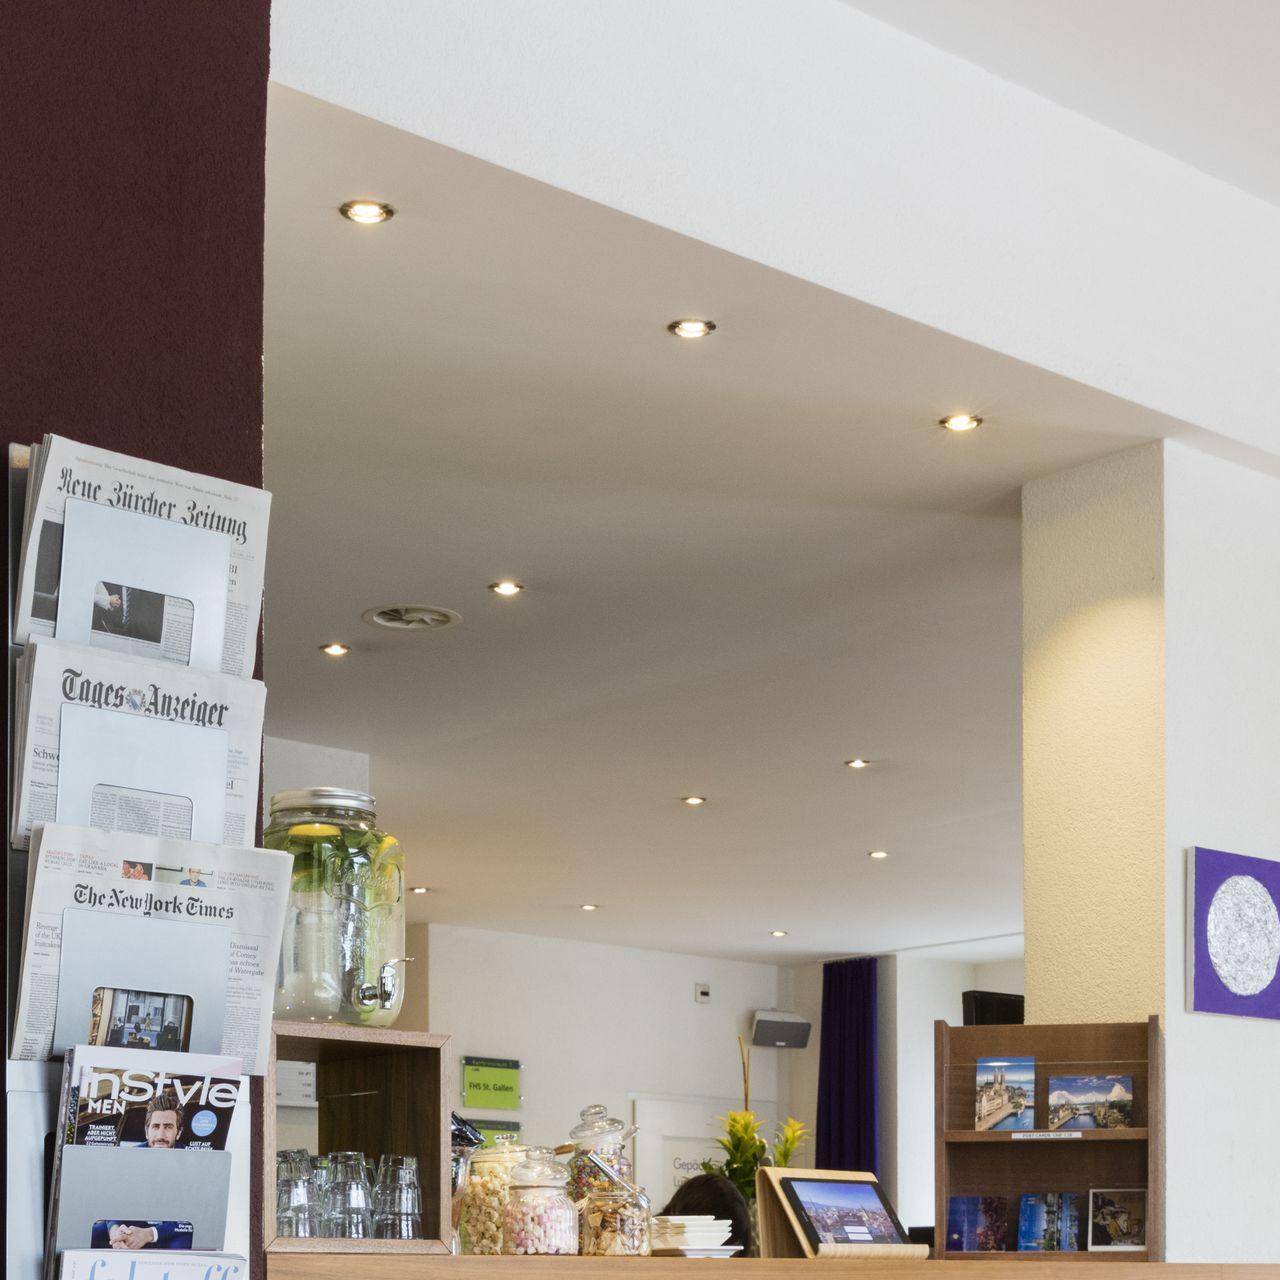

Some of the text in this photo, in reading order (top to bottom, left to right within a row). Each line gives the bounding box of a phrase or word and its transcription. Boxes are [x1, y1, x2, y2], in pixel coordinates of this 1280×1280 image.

[57, 466, 102, 501] Neue
[106, 480, 177, 518] Zürcher
[180, 500, 247, 545] Zeitung
[62, 668, 230, 728] Tages Anzeiger
[74, 883, 234, 919] The New York Times
[88, 1099, 126, 1115] MEN
